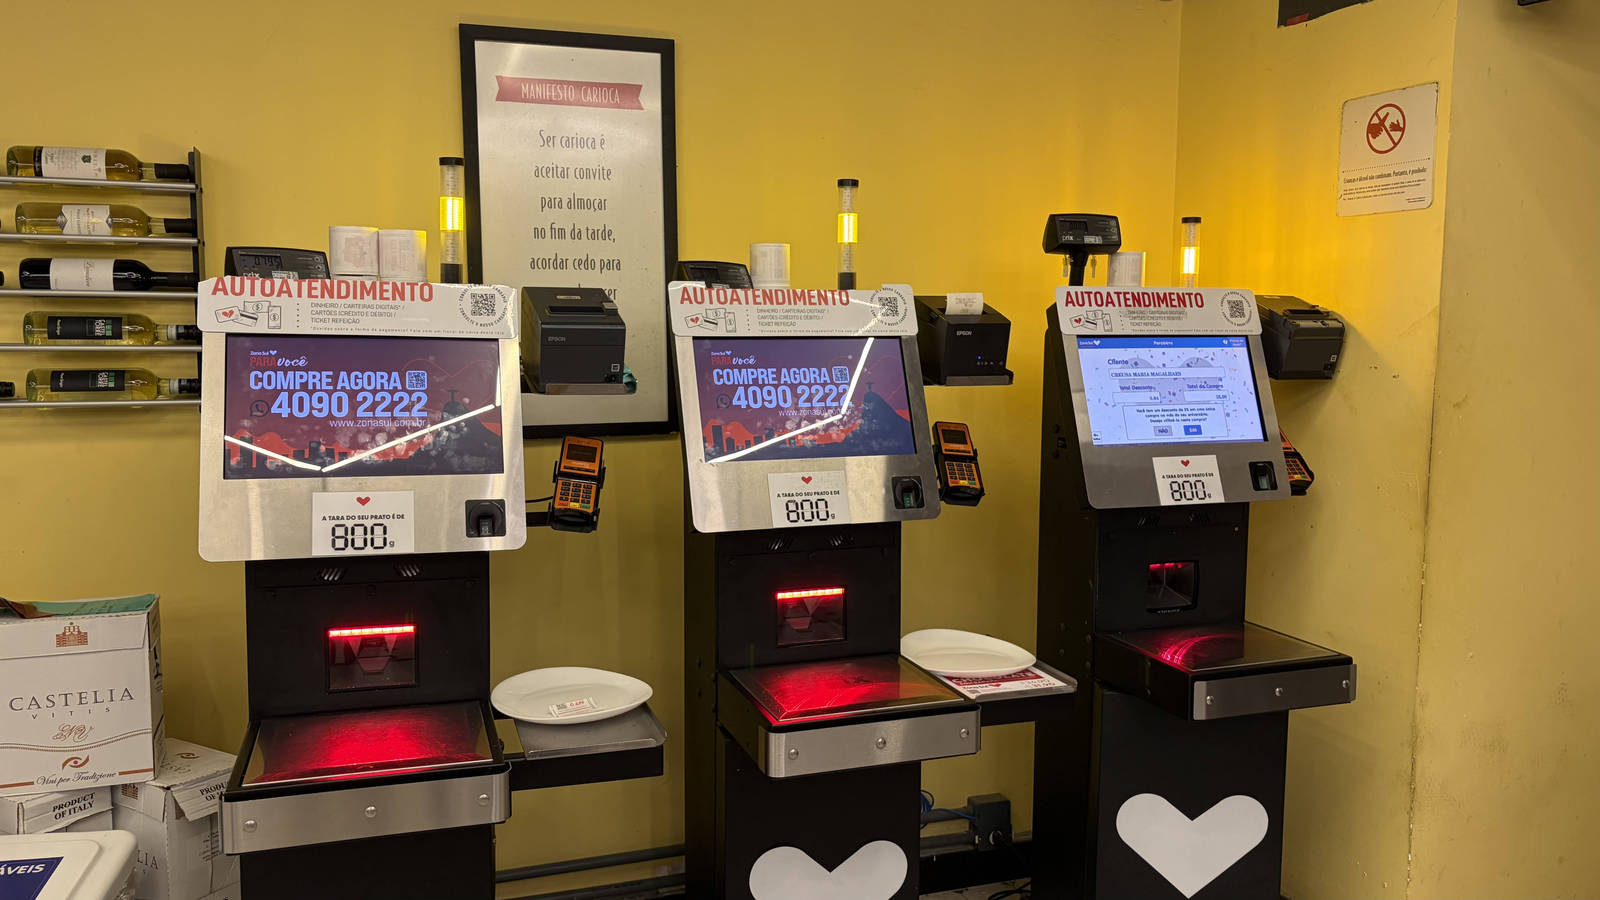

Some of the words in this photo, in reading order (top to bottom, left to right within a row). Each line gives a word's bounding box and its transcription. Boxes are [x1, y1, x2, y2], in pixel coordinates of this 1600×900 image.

[521, 82, 575, 101] MANIFESTO
[581, 86, 620, 104] CARIOCA
[539, 129, 556, 148] Ser
[560, 132, 596, 149] carioca
[600, 133, 606, 150] é
[534, 162, 570, 179] aceitar
[574, 164, 612, 181] convite
[540, 196, 563, 212] para
[566, 192, 607, 213] almoçar
[533, 226, 546, 239] no
[550, 222, 566, 240] fim
[570, 223, 582, 241] da
[585, 223, 616, 243] tarde,
[529, 253, 569, 270] acordar
[572, 253, 596, 271] cedo
[599, 258, 621, 274] para
[211, 276, 434, 302] AUTOATENDIMENTO
[680, 286, 850, 306] AUTOATENDIMENTO
[1065, 291, 1205, 308] AUTOATENDIMENTO
[331, 317, 360, 325] REFEIÇÃO
[250, 357, 277, 367] PARA
[276, 356, 308, 367] você
[732, 355, 756, 365] você
[250, 371, 334, 390] COMPRE
[337, 371, 402, 390] AGORA
[713, 368, 778, 385] COMPRE
[780, 367, 831, 384] AGORA
[271, 391, 349, 418] 4090
[356, 391, 428, 418] 2222
[732, 385, 792, 409] 4090
[796, 384, 854, 408] 2222
[329, 418, 426, 428] www.zonasul.com.br
[9, 687, 135, 712] CASTELIA
[32, 707, 110, 720] VITIS
[57, 775, 71, 784] per
[71, 771, 117, 783] Tradizione
[52, 792, 96, 813] PRODUCT
[54, 809, 67, 820] OF
[67, 801, 95, 818] ITALY
